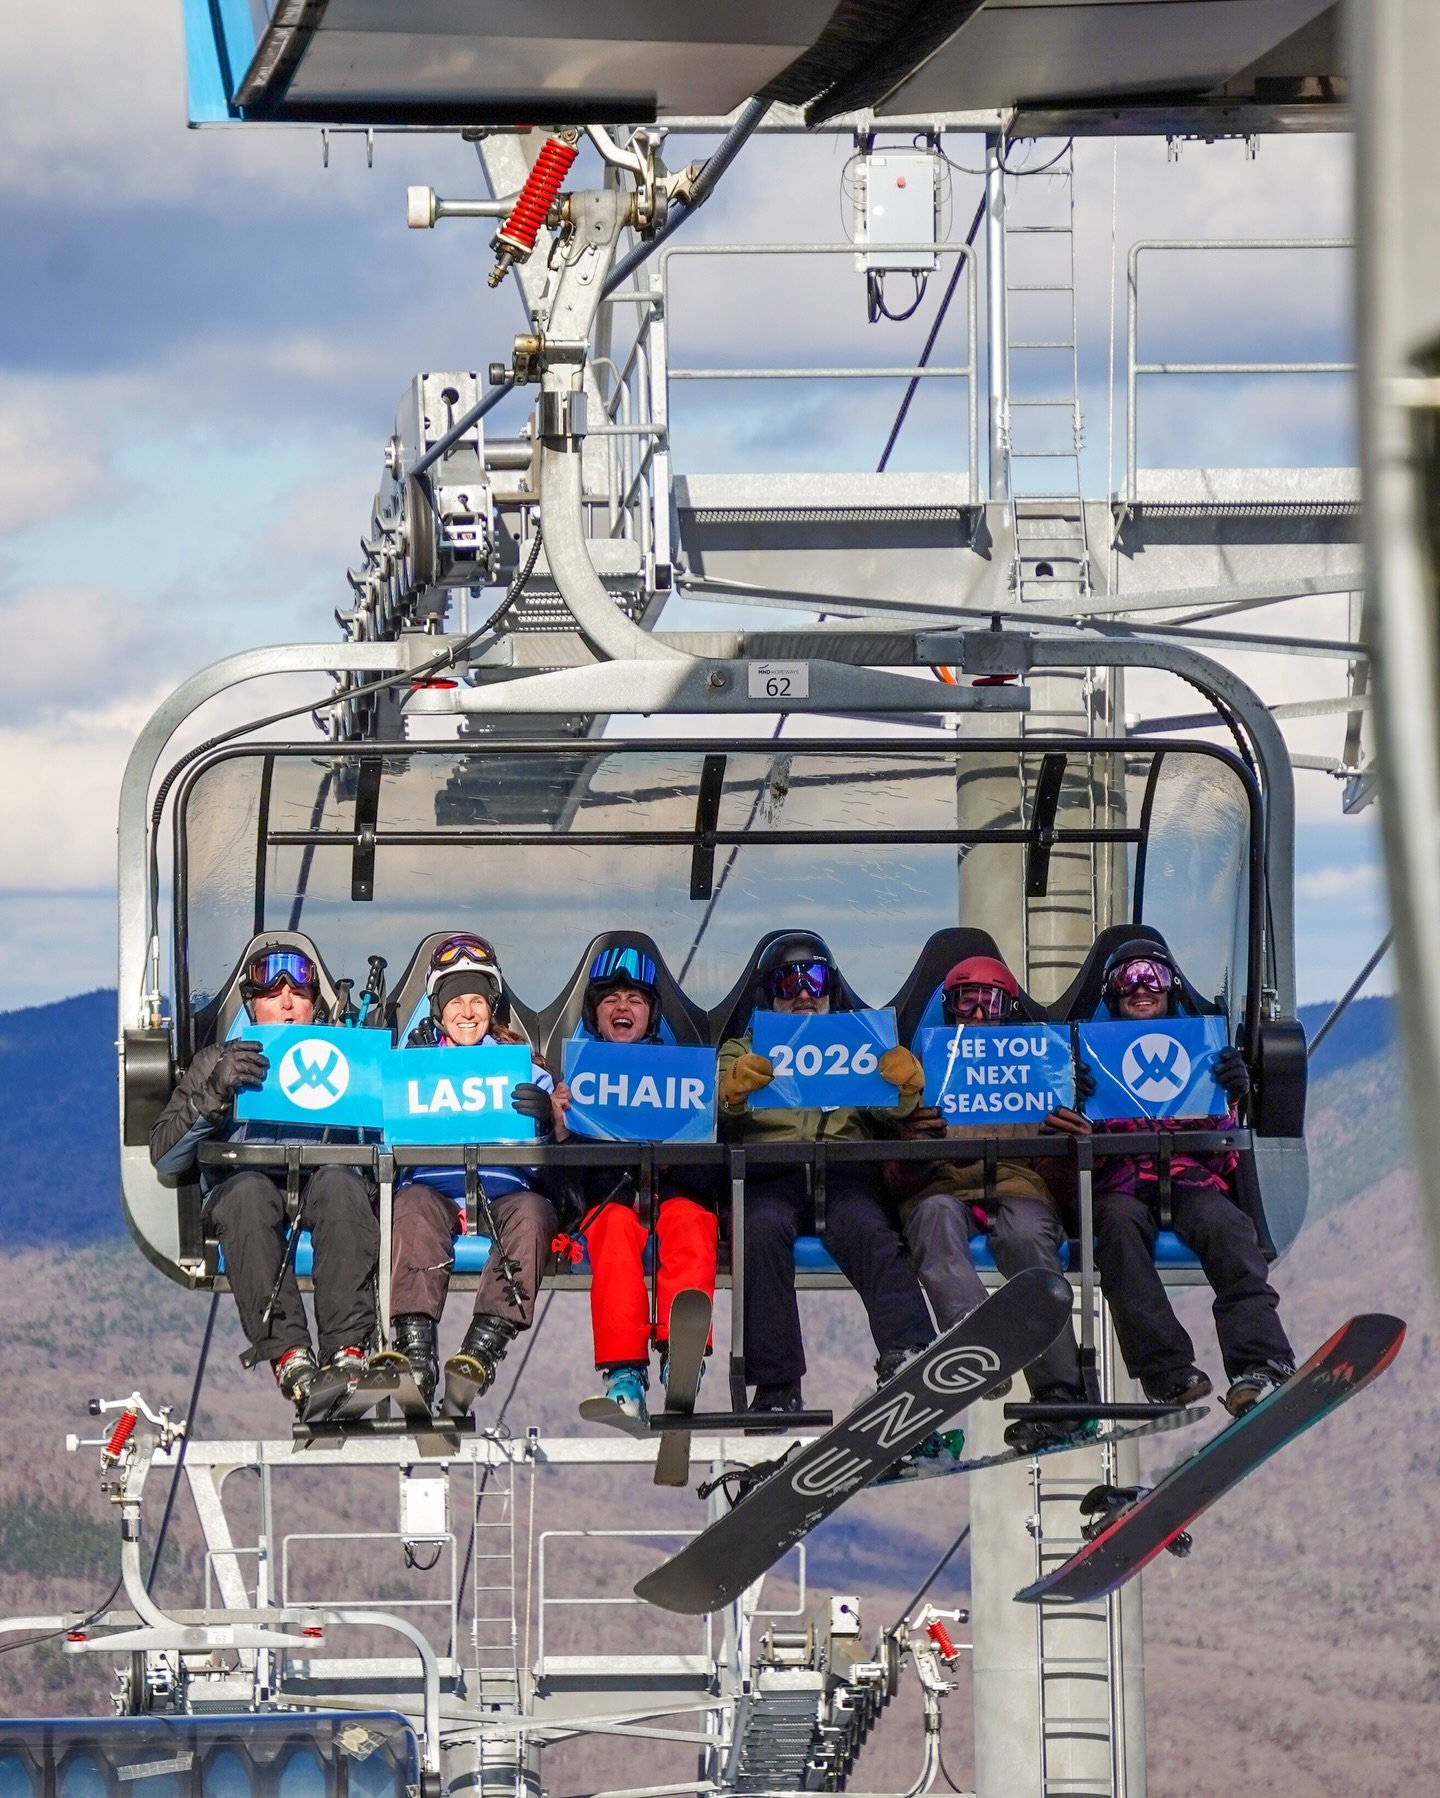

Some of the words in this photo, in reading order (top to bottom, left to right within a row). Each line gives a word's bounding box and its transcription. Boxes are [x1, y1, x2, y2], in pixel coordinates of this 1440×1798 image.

[766, 677, 791, 696] 62
[768, 1043, 878, 1077] 2026
[946, 1038, 986, 1059] SEE
[992, 1037, 1047, 1057] YOU
[966, 1065, 1031, 1085] NEXT
[408, 1076, 509, 1114] LAST
[570, 1072, 706, 1110] CHAIR
[943, 1092, 1054, 1114] SEASON!
[791, 1345, 1001, 1496] GNU
